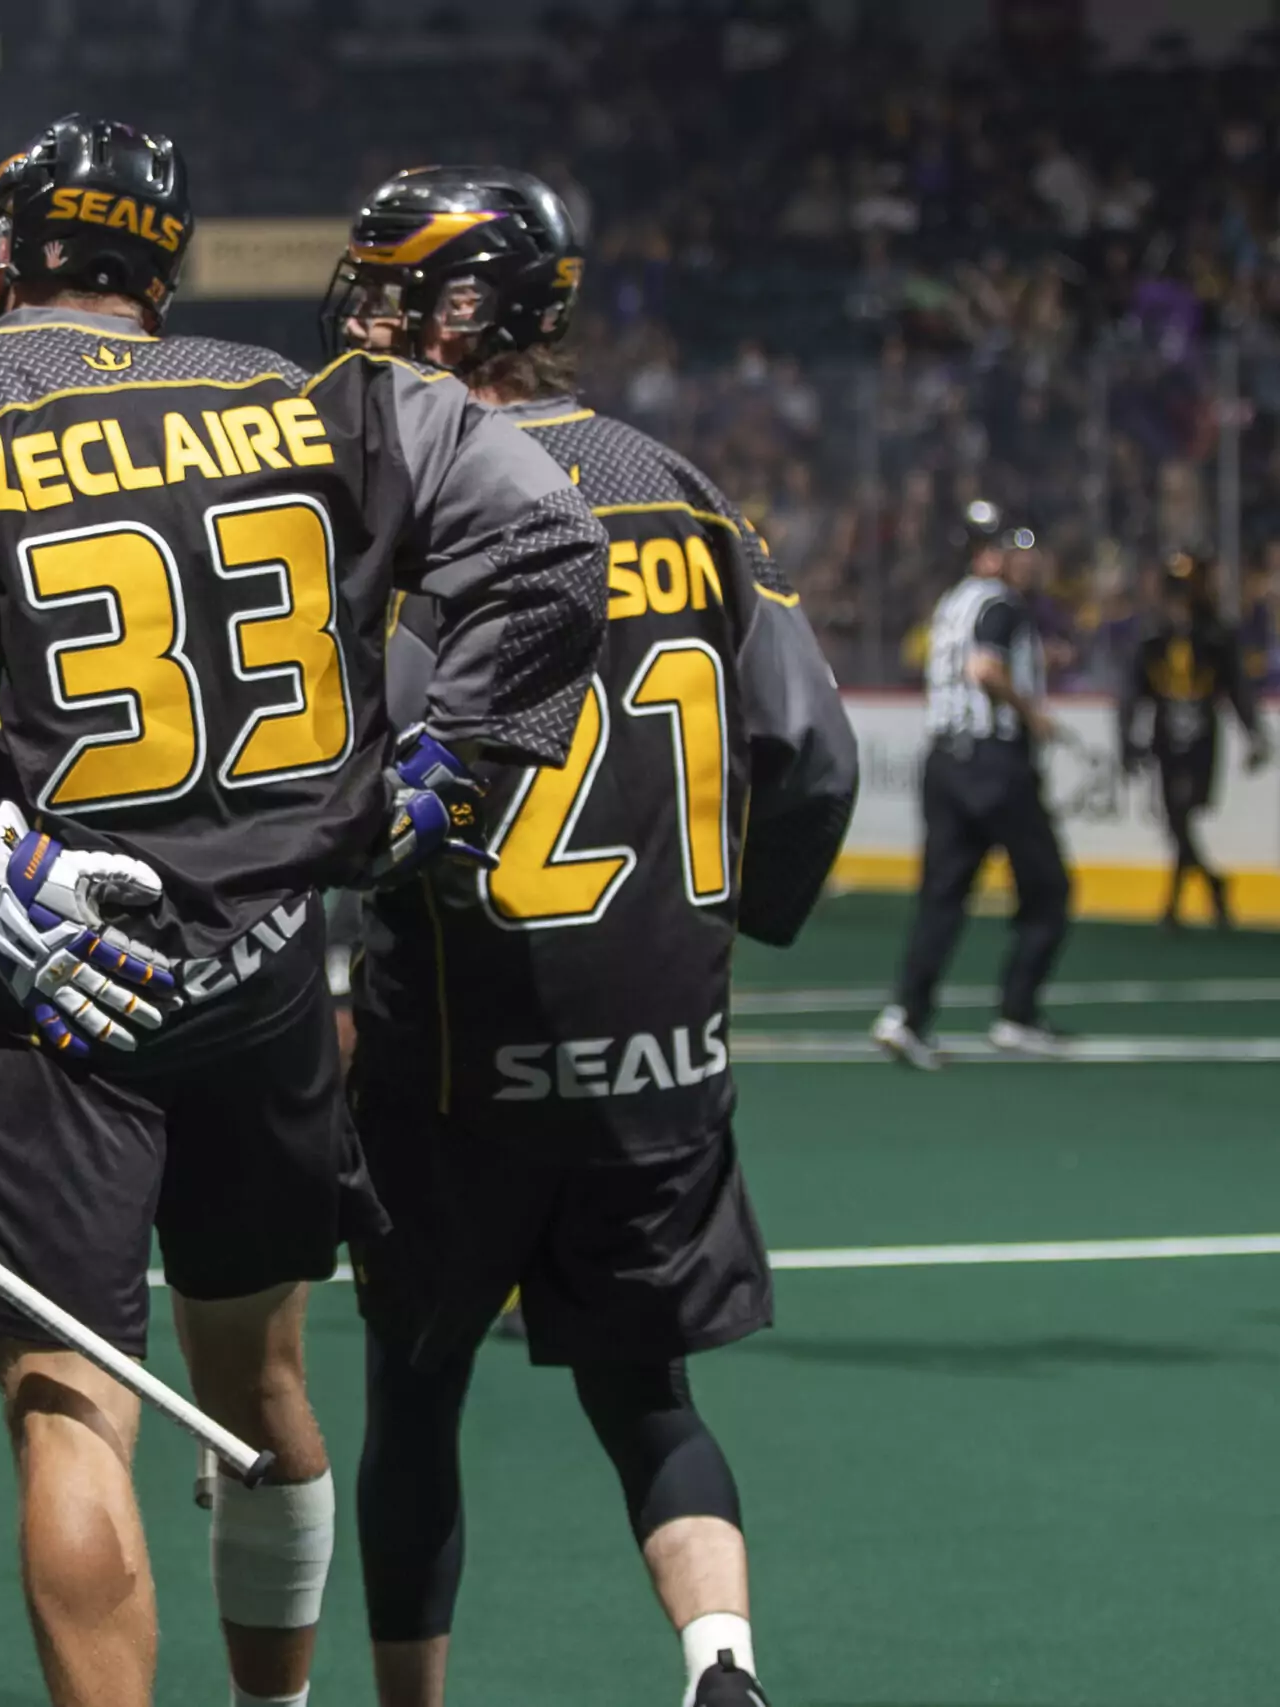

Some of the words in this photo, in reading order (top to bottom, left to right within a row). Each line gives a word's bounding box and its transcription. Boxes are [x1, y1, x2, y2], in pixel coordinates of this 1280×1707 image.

[46, 186, 184, 252] SEALS
[17, 493, 355, 815] 33
[478, 638, 730, 931] 21
[493, 1011, 728, 1100] SEALS
